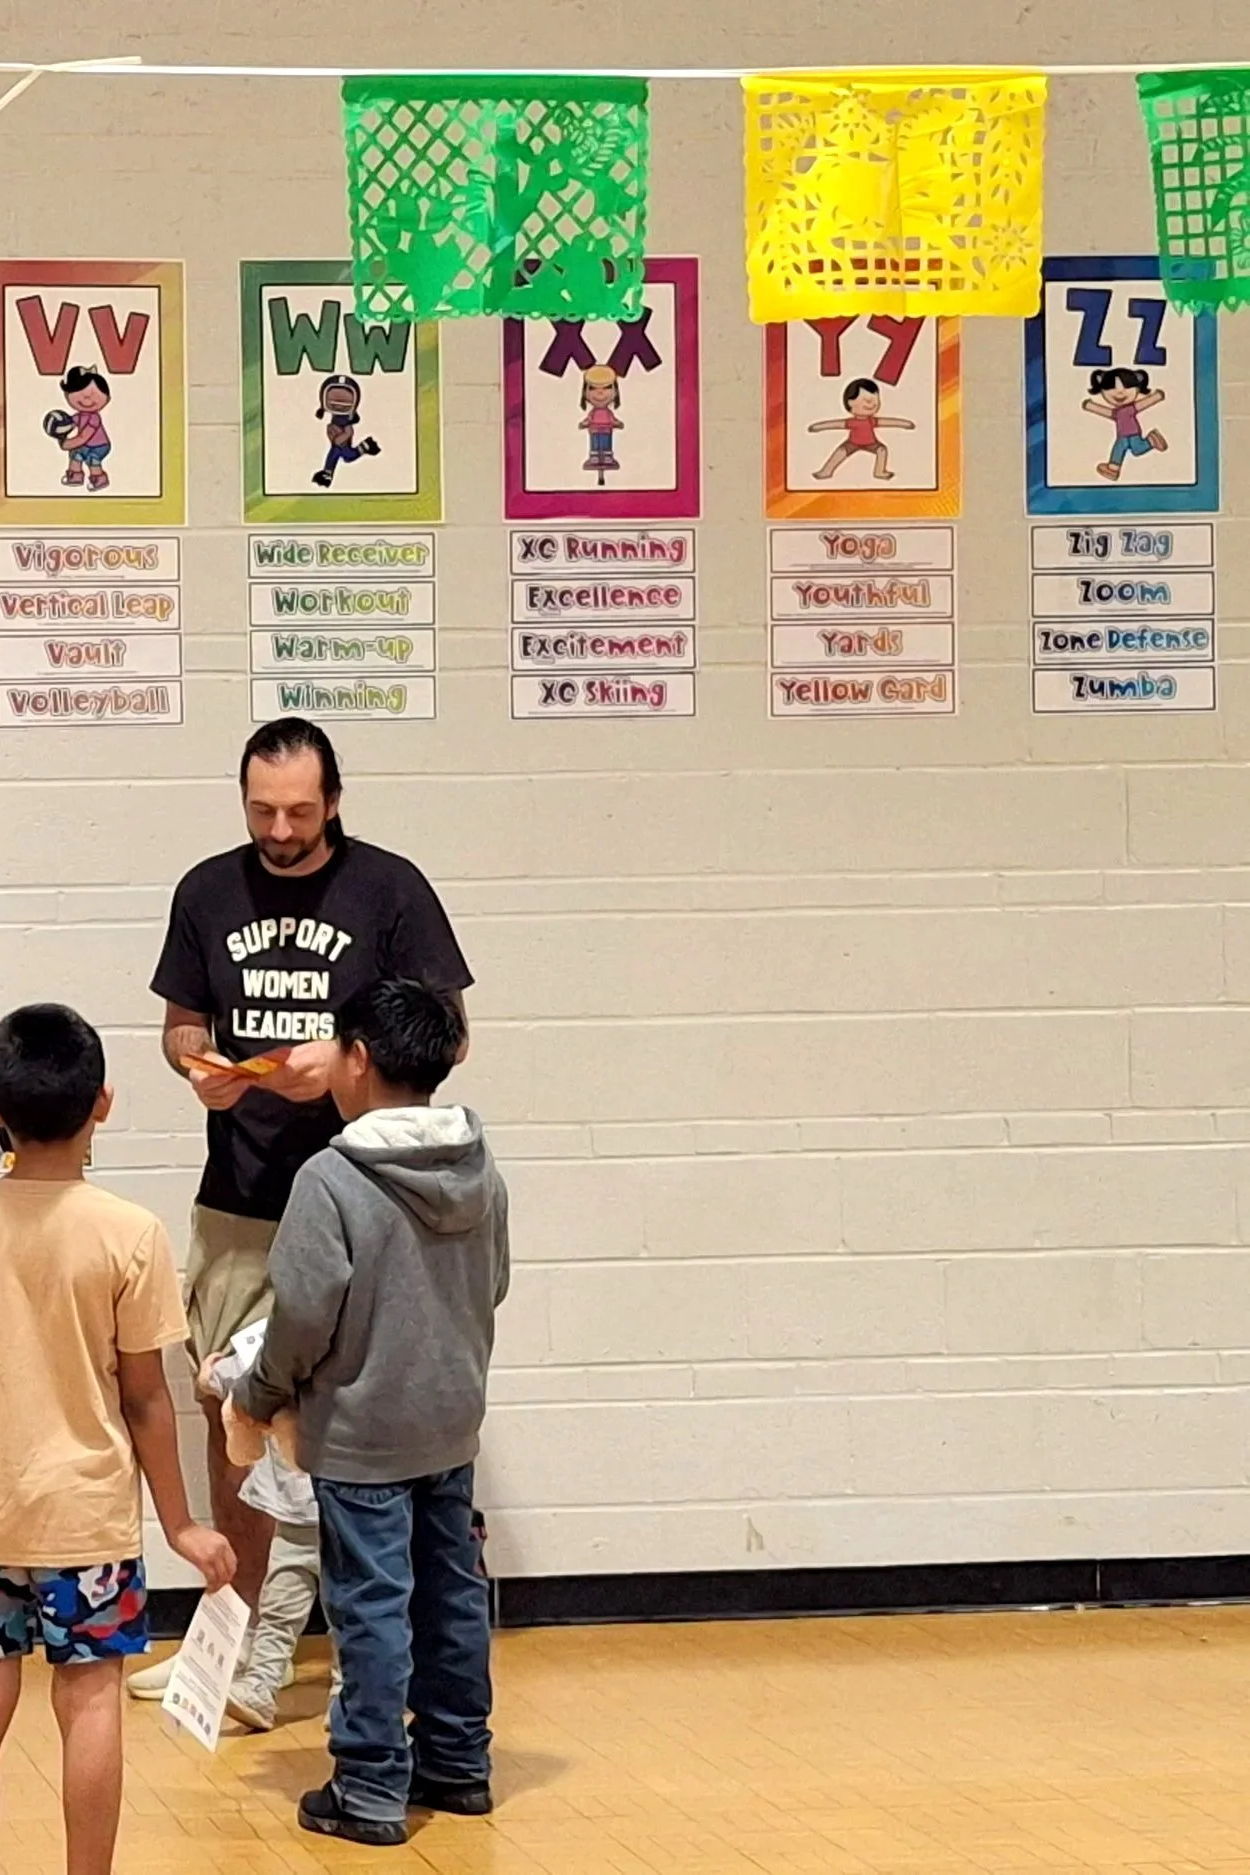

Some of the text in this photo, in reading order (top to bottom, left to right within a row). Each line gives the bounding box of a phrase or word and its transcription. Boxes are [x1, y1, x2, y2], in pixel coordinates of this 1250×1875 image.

[14, 542, 157, 574] Vigorous
[255, 540, 428, 566] Wide Receiver
[519, 533, 686, 565] XC Running
[821, 531, 895, 562] Yoga
[1068, 528, 1173, 559] Zig Zag
[273, 587, 410, 614] Workout
[527, 584, 680, 609] Excellence
[794, 579, 929, 607] Youthful
[1079, 578, 1169, 604] Zoom
[0, 591, 173, 621] Vertical Leap
[46, 640, 125, 667] Vault
[273, 634, 412, 662] Warm-up
[521, 632, 687, 658] Excitement
[819, 628, 902, 655] Yards
[1041, 626, 1208, 653] Zone Defense
[279, 681, 406, 713] Winning
[540, 677, 666, 708] XC Skiing
[777, 675, 945, 704] Yellow Card
[1072, 671, 1176, 699] Zumba
[8, 687, 169, 718] Volleyball
[227, 917, 352, 962] SUPPORT
[242, 969, 329, 1000] WOMEN
[232, 1008, 334, 1040] LEADERS
